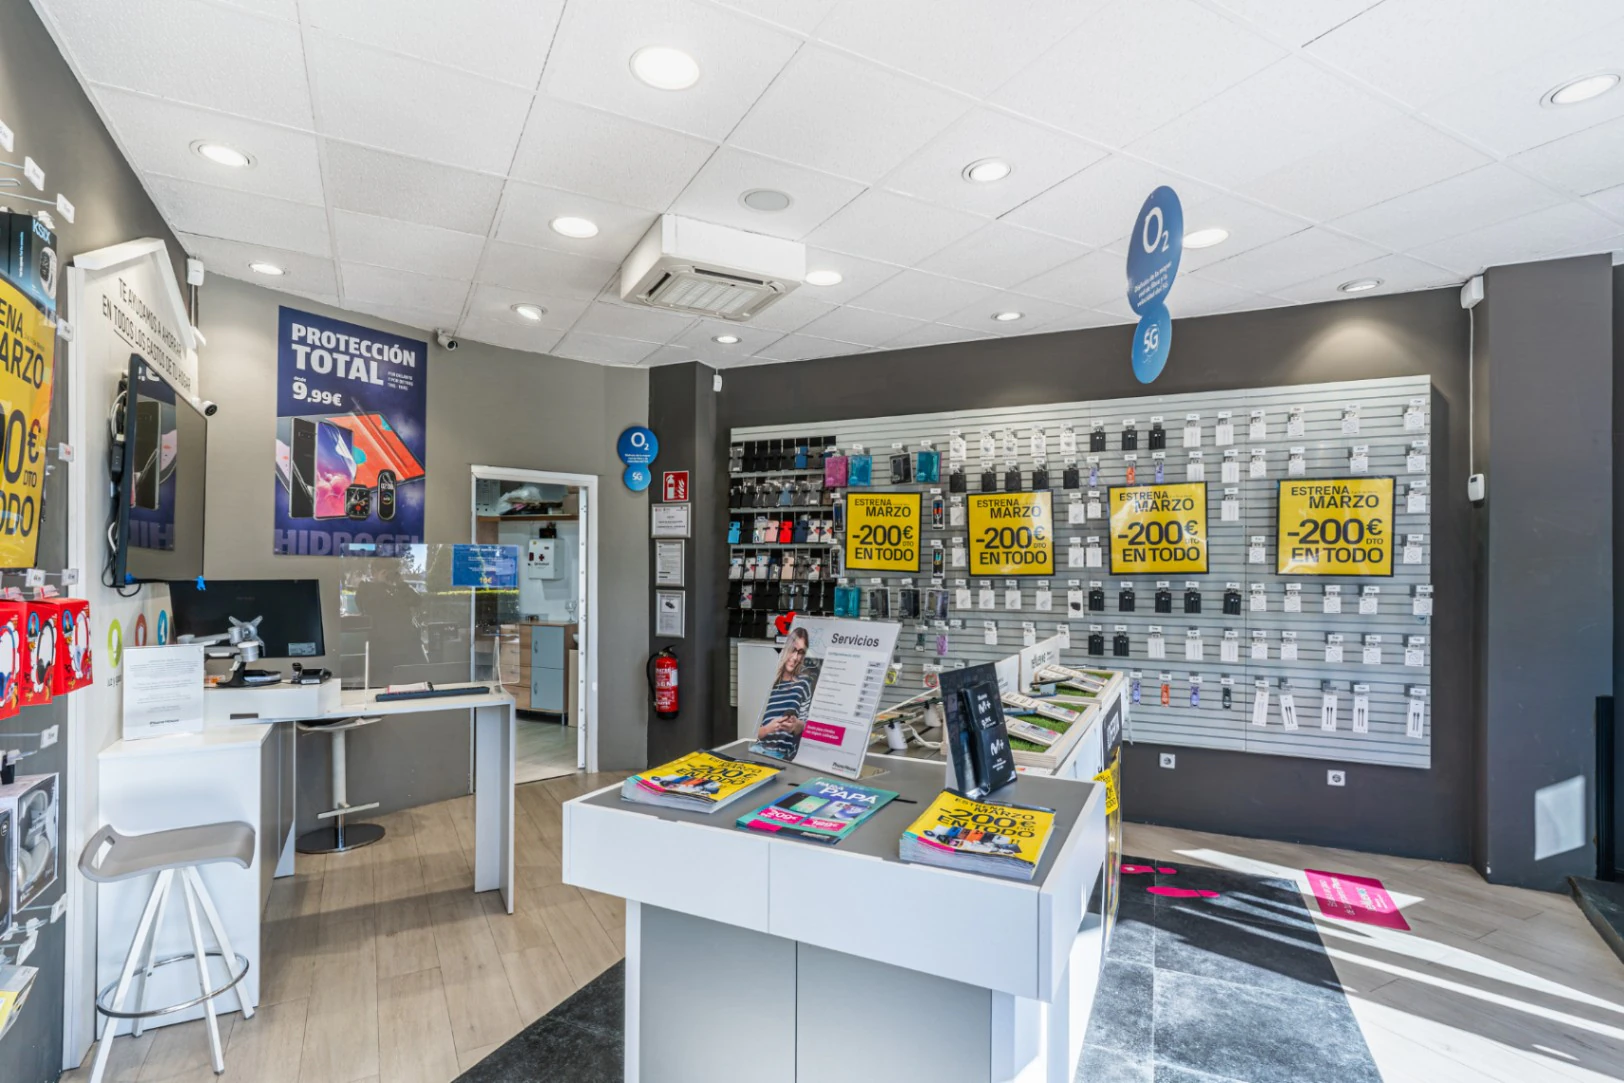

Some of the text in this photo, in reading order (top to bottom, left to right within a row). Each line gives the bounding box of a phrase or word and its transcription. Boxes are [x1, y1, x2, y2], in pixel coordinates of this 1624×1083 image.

[119, 277, 127, 303] TE
[103, 294, 112, 321] EN
[114, 304, 134, 341] TODOS
[292, 322, 416, 368] PROTECCIÓN
[292, 344, 384, 386] TOTAL
[23, 469, 37, 488] DTO
[1119, 491, 1169, 502] ESTRENA
[1291, 485, 1350, 496] ESTRENA
[854, 499, 892, 507] ESTRENA
[977, 499, 1019, 508] ESTRENA
[1135, 498, 1195, 512] MARZO
[1309, 495, 1379, 508] MARZO
[866, 507, 912, 518] MARZO
[990, 506, 1042, 519] MARZO
[855, 548, 914, 562] EN TODO
[980, 551, 1047, 566] EN TODO
[1122, 546, 1201, 563] EN TODO
[1292, 547, 1384, 563] EN TODO
[831, 632, 879, 648] Servicios
[954, 798, 1005, 811] ESTRENA
[973, 806, 1035, 821] MARZO
[937, 815, 1035, 839] EN TODO
